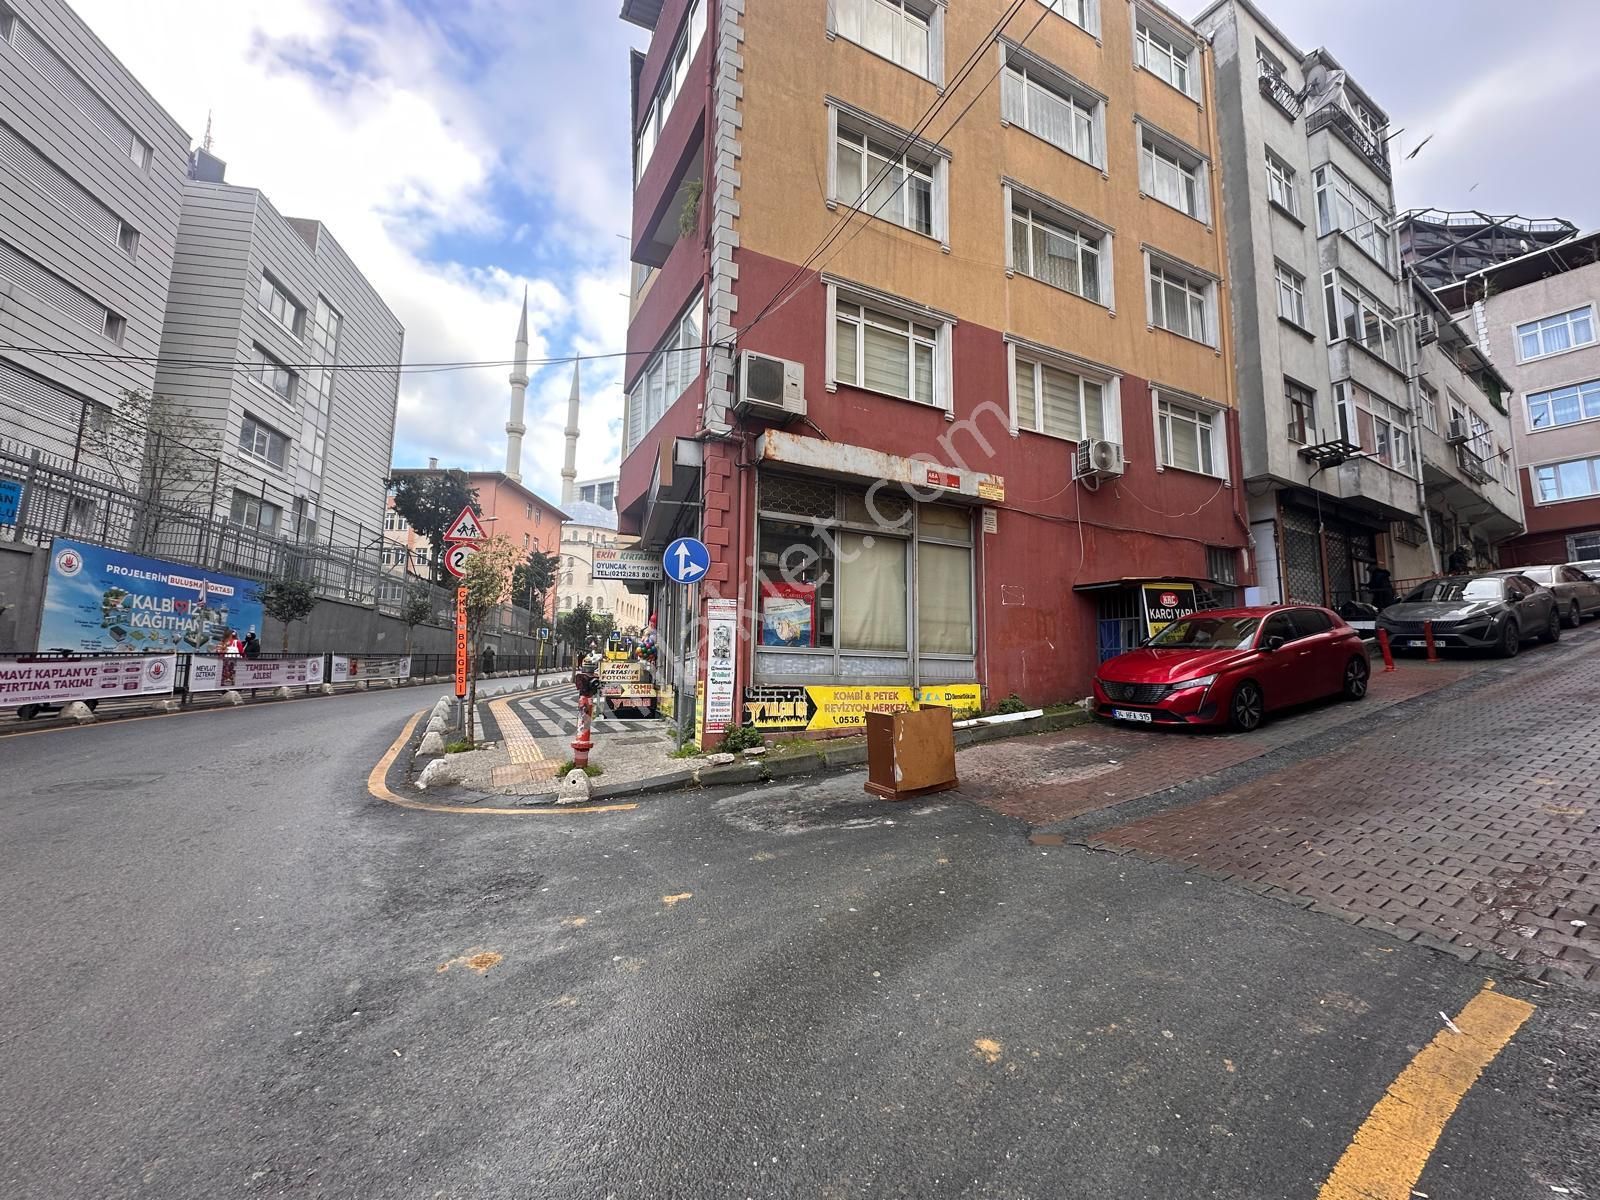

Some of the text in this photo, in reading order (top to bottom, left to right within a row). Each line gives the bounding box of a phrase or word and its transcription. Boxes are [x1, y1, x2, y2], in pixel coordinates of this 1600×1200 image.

[454, 552, 464, 568] 2
[596, 562, 627, 570] OYUNCAK
[106, 564, 168, 583] PROJELERİN
[1149, 608, 1174, 619] KARCI
[0, 667, 98, 680] MAVİ KAPLAN VE
[0, 680, 50, 692] FIRTINA
[54, 678, 94, 689] TAKIMI
[833, 689, 899, 701] KOMBİ & PETEK
[824, 702, 870, 713] REVİZYON
[839, 716, 860, 724] 0536
